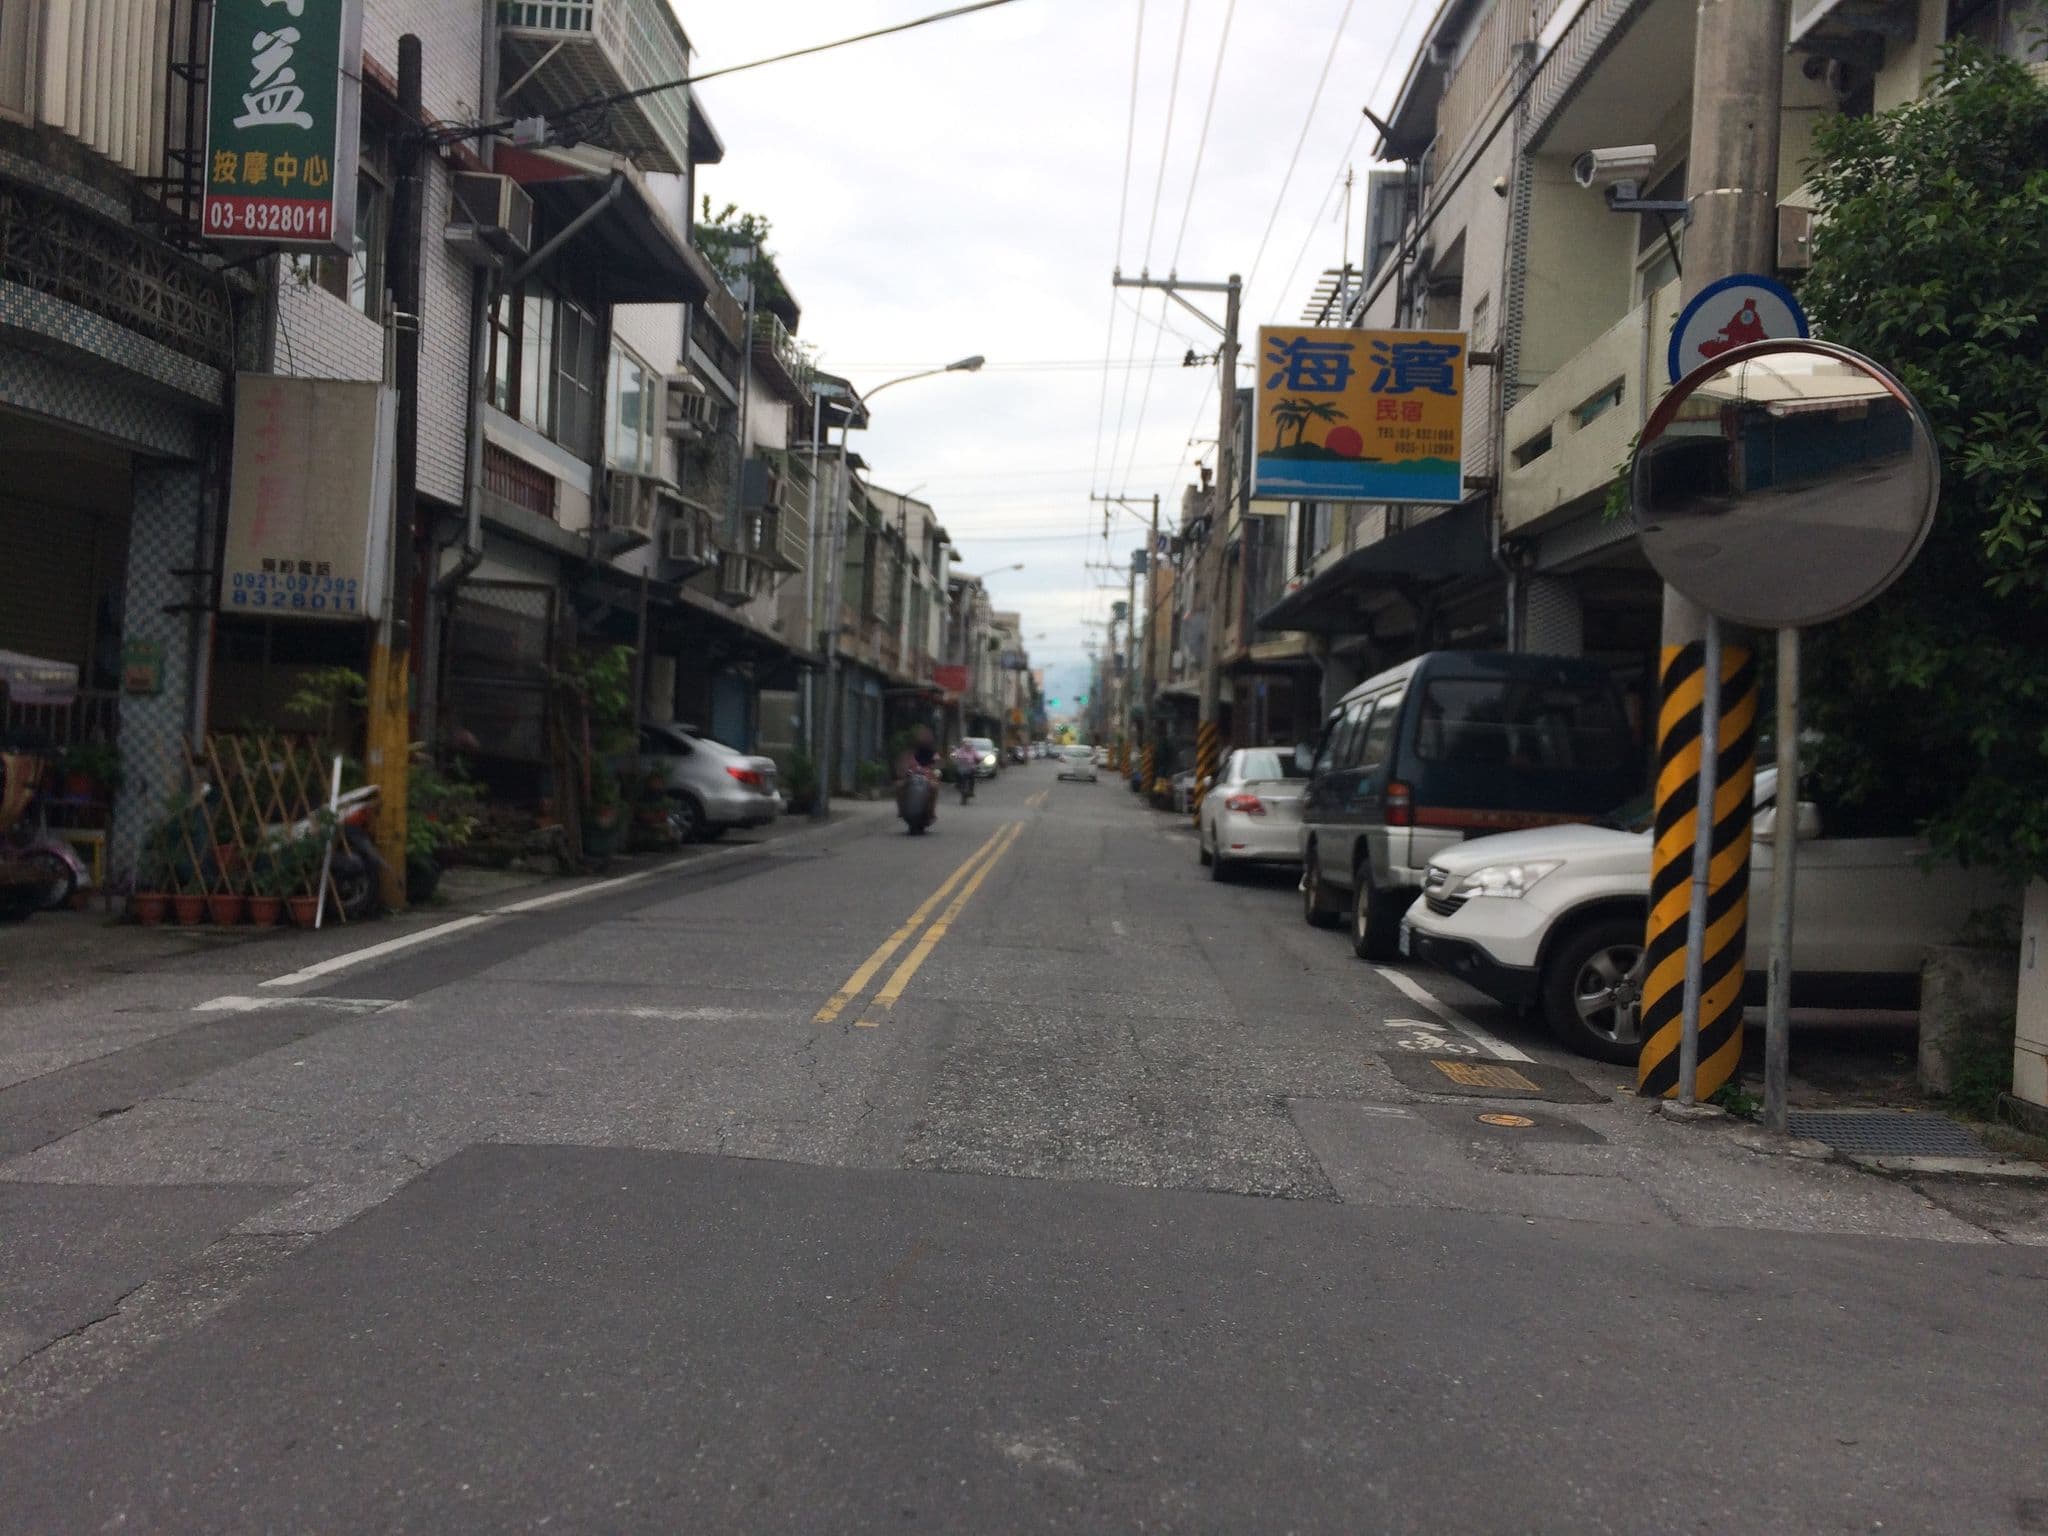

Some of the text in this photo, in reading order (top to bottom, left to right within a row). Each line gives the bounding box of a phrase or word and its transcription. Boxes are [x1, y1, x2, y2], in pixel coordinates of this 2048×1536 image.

[212, 149, 330, 187] 按摩中心
[210, 202, 328, 233] 03-8328011
[1267, 336, 1462, 395] 海濱
[1376, 399, 1424, 423] 民宿
[233, 590, 356, 609] 8328011
